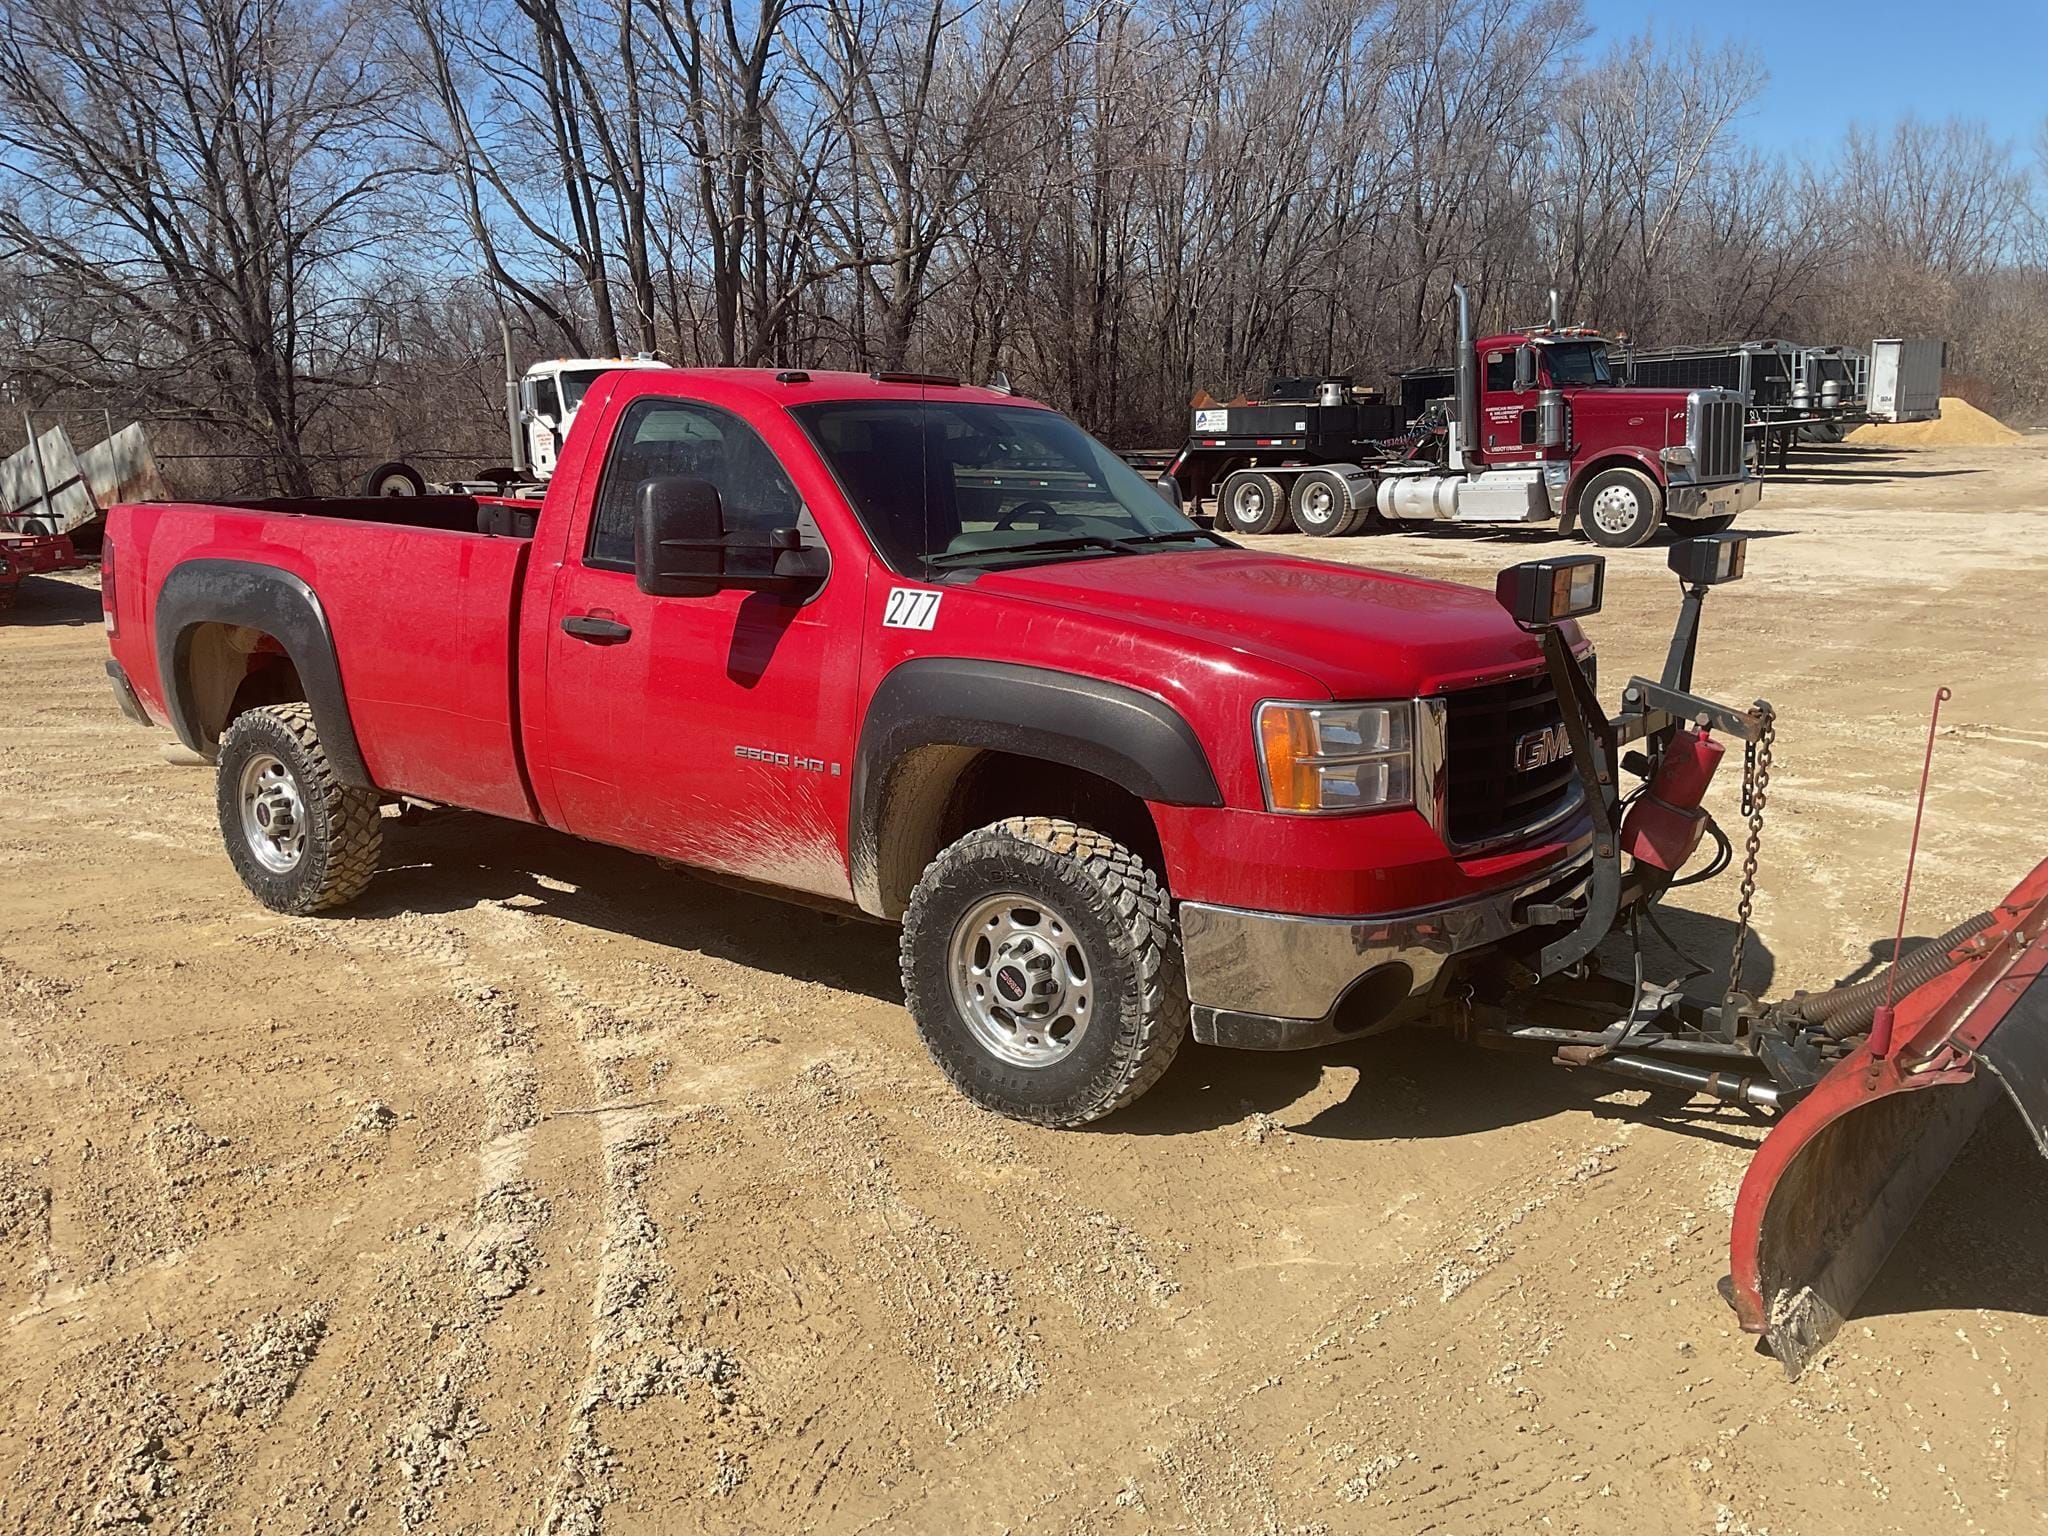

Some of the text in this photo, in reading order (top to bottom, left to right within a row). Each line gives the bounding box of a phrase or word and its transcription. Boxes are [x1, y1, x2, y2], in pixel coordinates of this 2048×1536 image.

[886, 591, 940, 627] 277
[735, 745, 824, 772] 2500 HD
[1000, 970, 1024, 997] GMC
